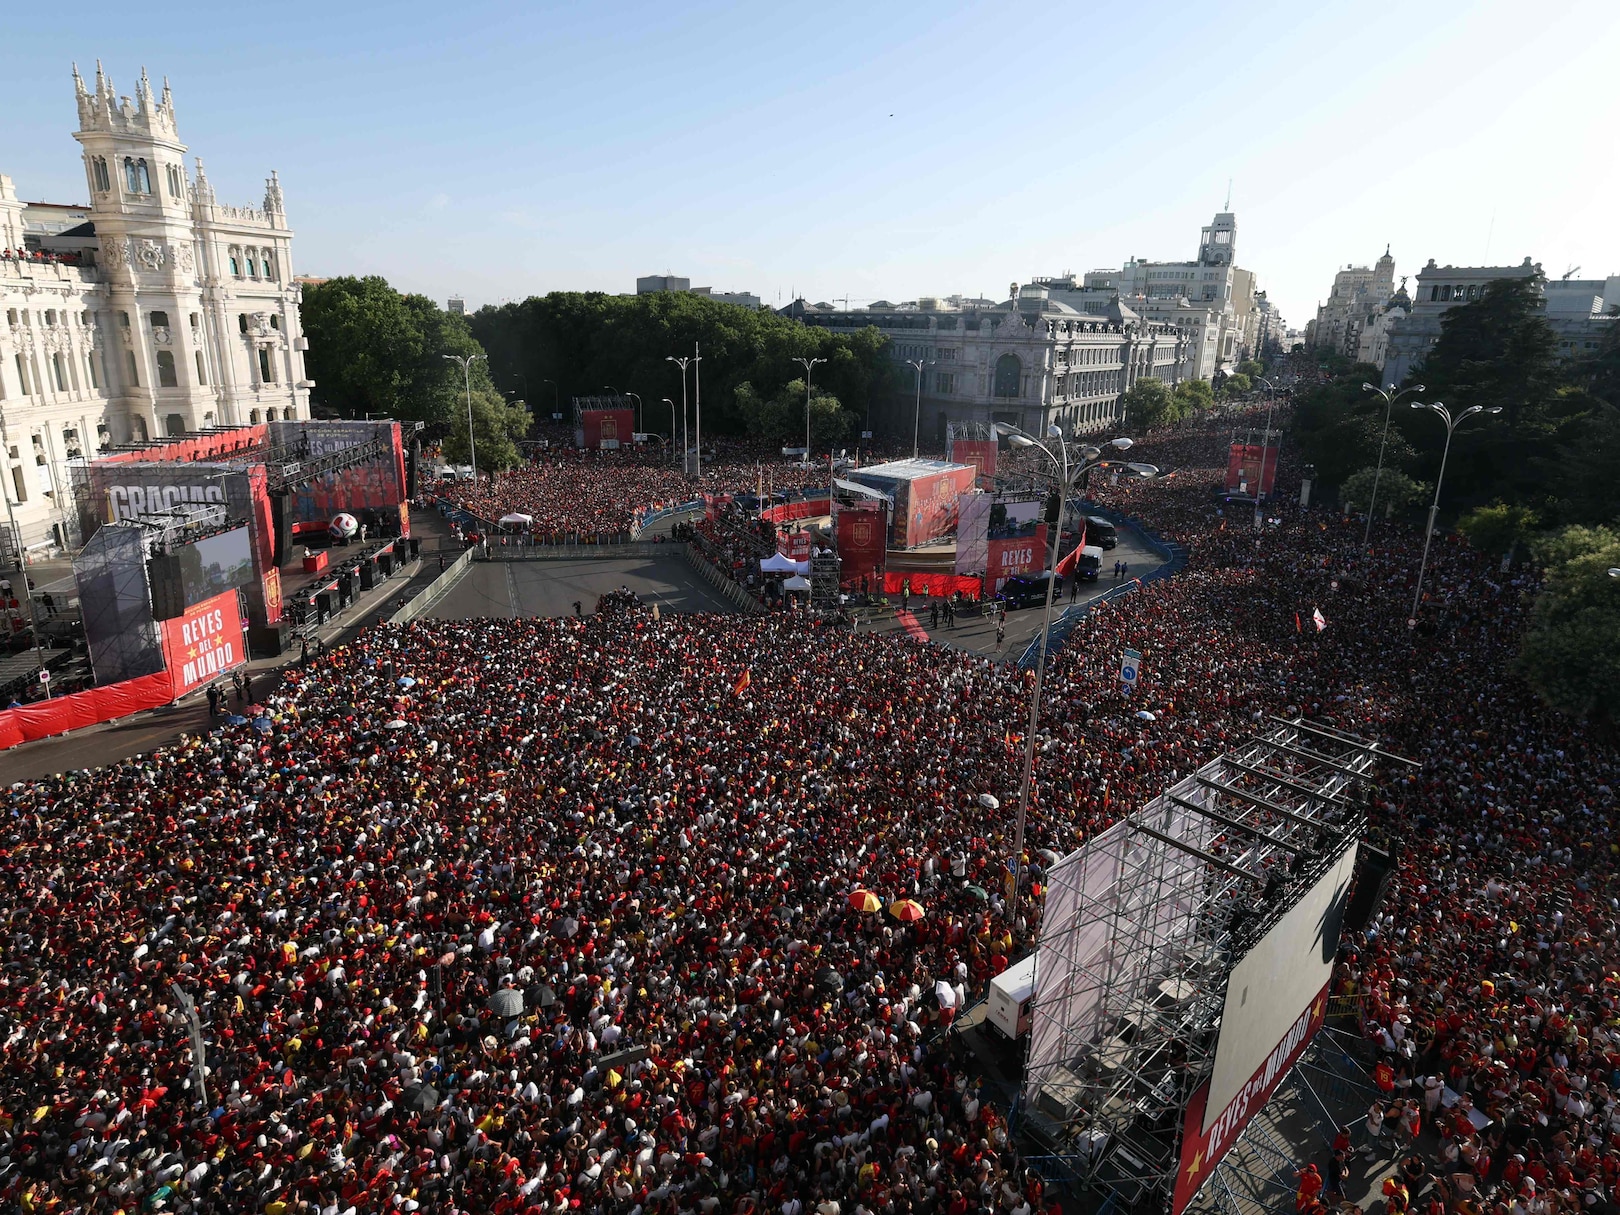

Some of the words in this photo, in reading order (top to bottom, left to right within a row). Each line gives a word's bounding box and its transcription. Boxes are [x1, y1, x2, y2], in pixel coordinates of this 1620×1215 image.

[1001, 548, 1032, 566] REYES
[182, 609, 223, 646] REYES
[198, 638, 213, 654] DEL
[182, 642, 233, 687] MUNDO
[1205, 1080, 1253, 1164] REYES
[1251, 1074, 1263, 1098] DEL
[1261, 1006, 1312, 1093] MUNDO
[1380, 1072, 1389, 1083] 19
